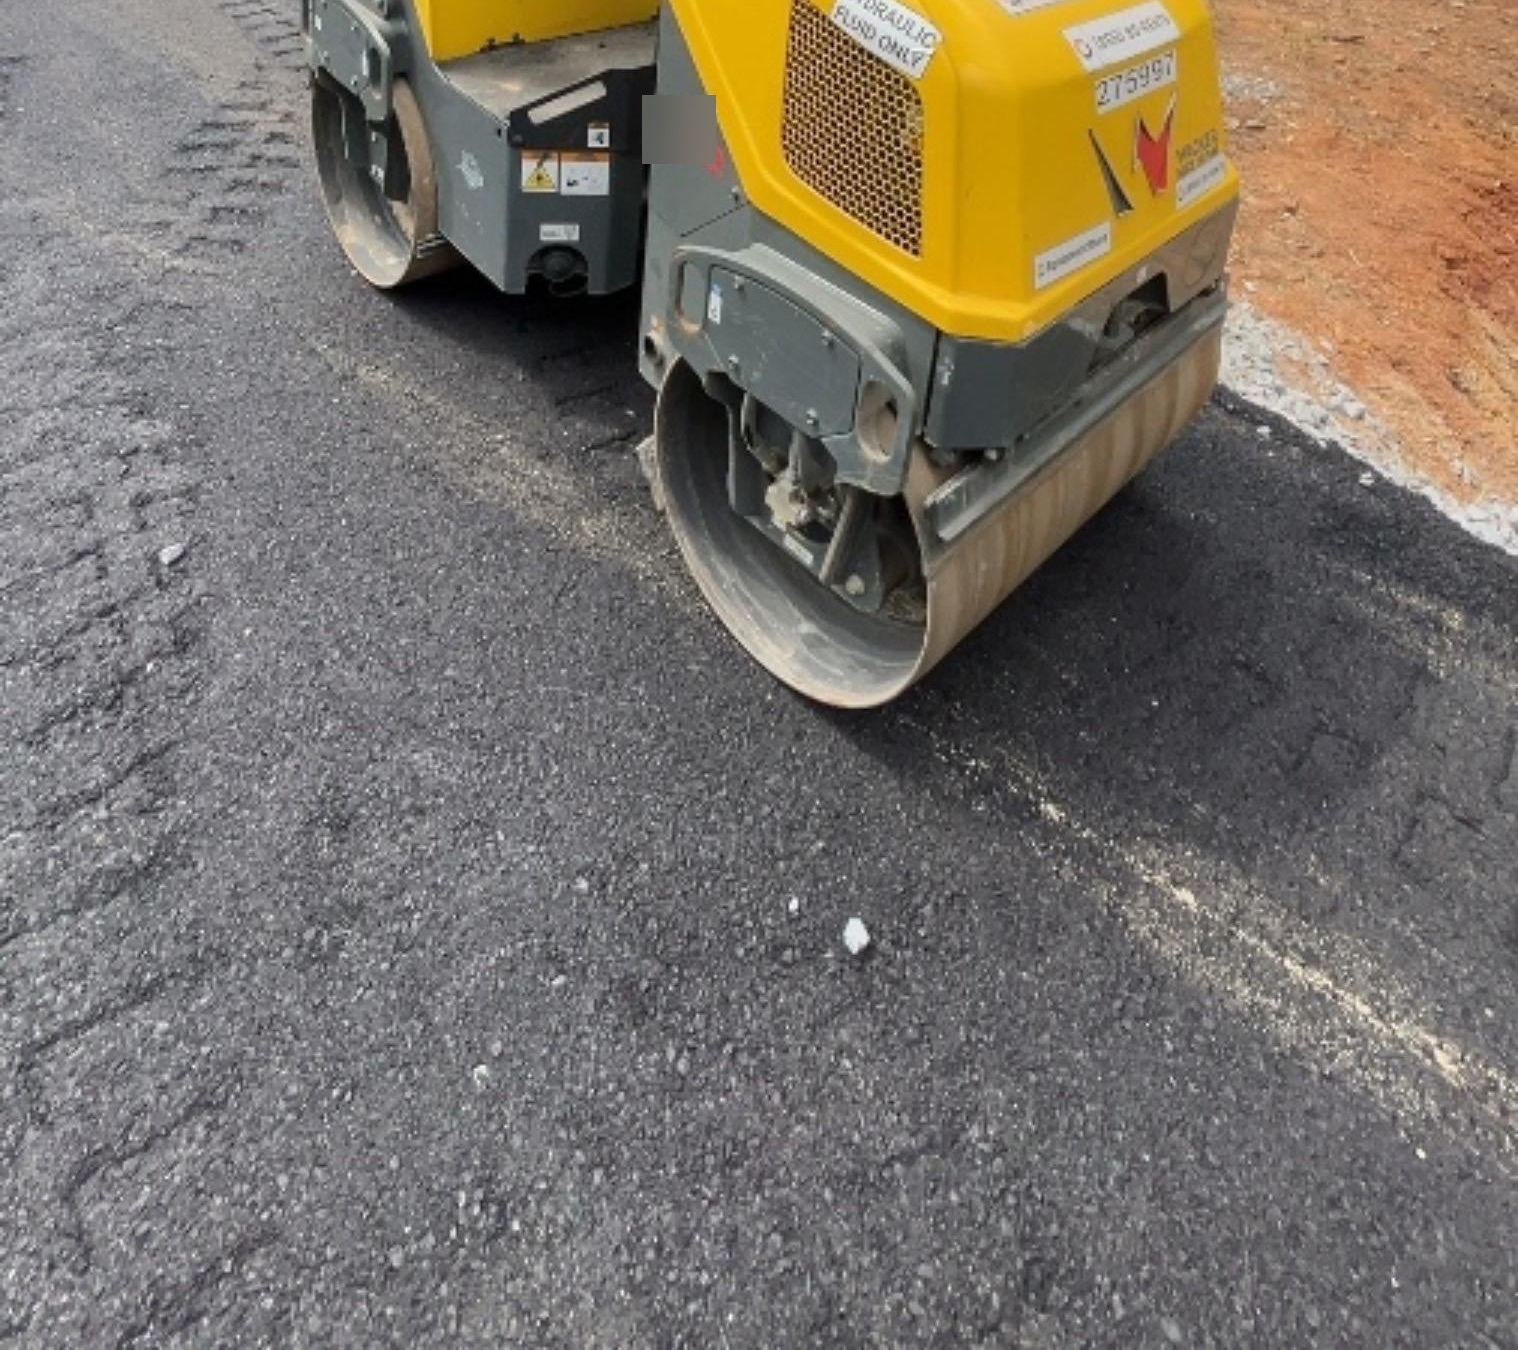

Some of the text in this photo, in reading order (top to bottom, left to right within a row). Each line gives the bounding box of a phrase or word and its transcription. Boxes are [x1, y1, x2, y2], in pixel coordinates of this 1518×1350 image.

[834, 5, 924, 68] FLUID ONLY
[1096, 51, 1174, 107] 275997
